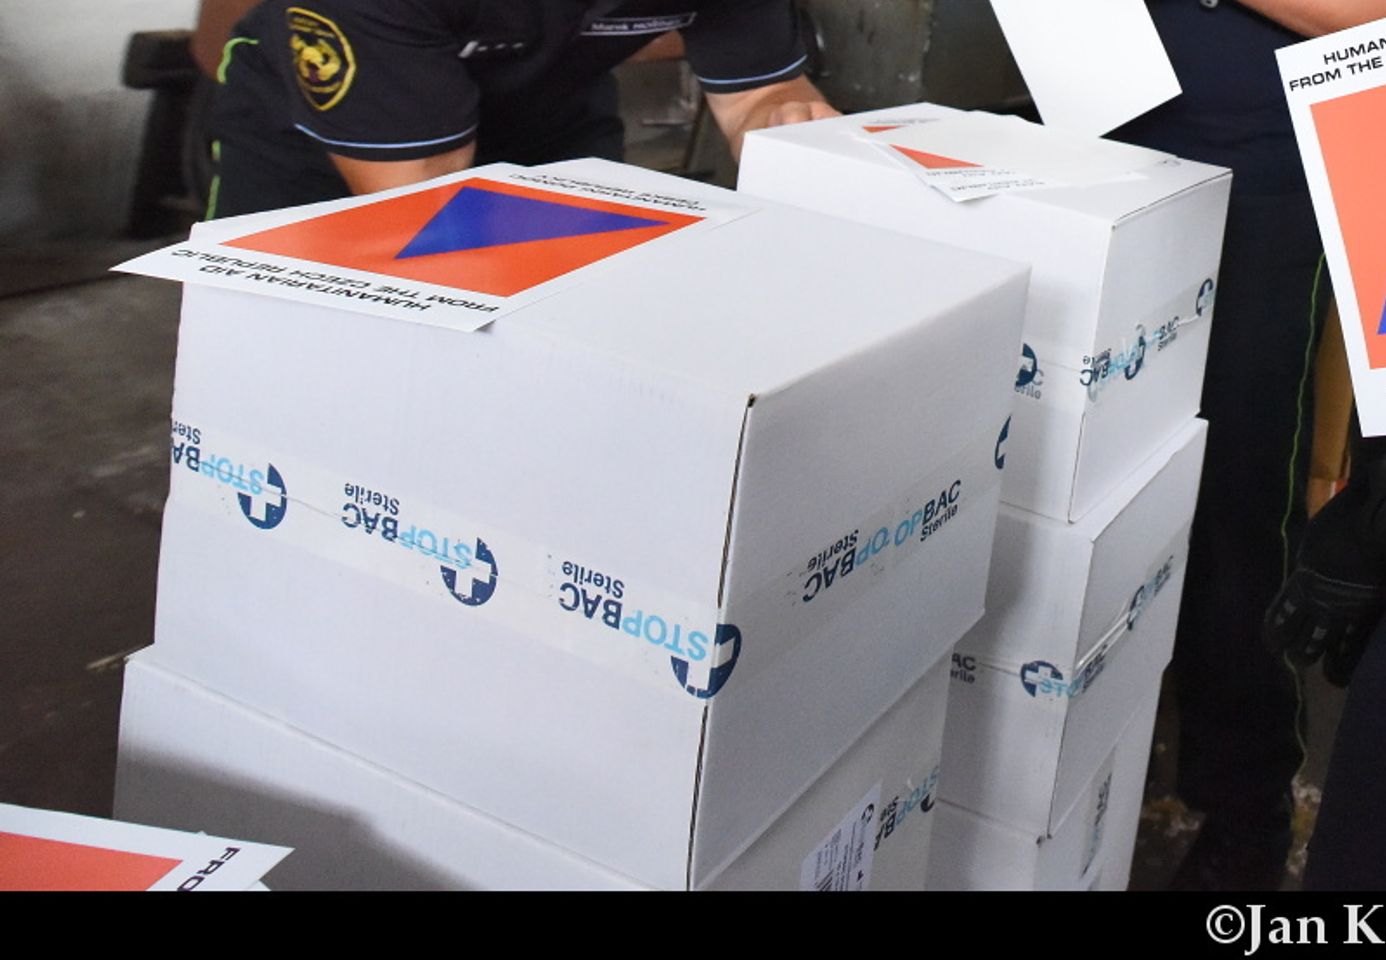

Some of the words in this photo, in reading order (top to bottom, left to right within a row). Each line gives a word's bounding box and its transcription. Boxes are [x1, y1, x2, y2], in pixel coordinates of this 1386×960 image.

[1288, 67, 1342, 92] FROM
[1347, 57, 1384, 77] THE
[171, 248, 287, 274] REPUBLIC
[199, 264, 244, 278] AID
[251, 271, 432, 312] HUMANITARIAN
[289, 269, 372, 290] CZECH
[374, 284, 420, 299] THE
[427, 294, 500, 313] FROM
[173, 421, 202, 445] Ster
[172, 442, 264, 495] STOPBA
[344, 482, 400, 516] Sterile
[341, 503, 473, 569] STOPBAC
[920, 504, 958, 542] Sterile
[807, 529, 859, 572] Sterile
[562, 561, 625, 599] Sterile
[558, 582, 709, 661] STOPBAC
[177, 846, 240, 891] FRO
